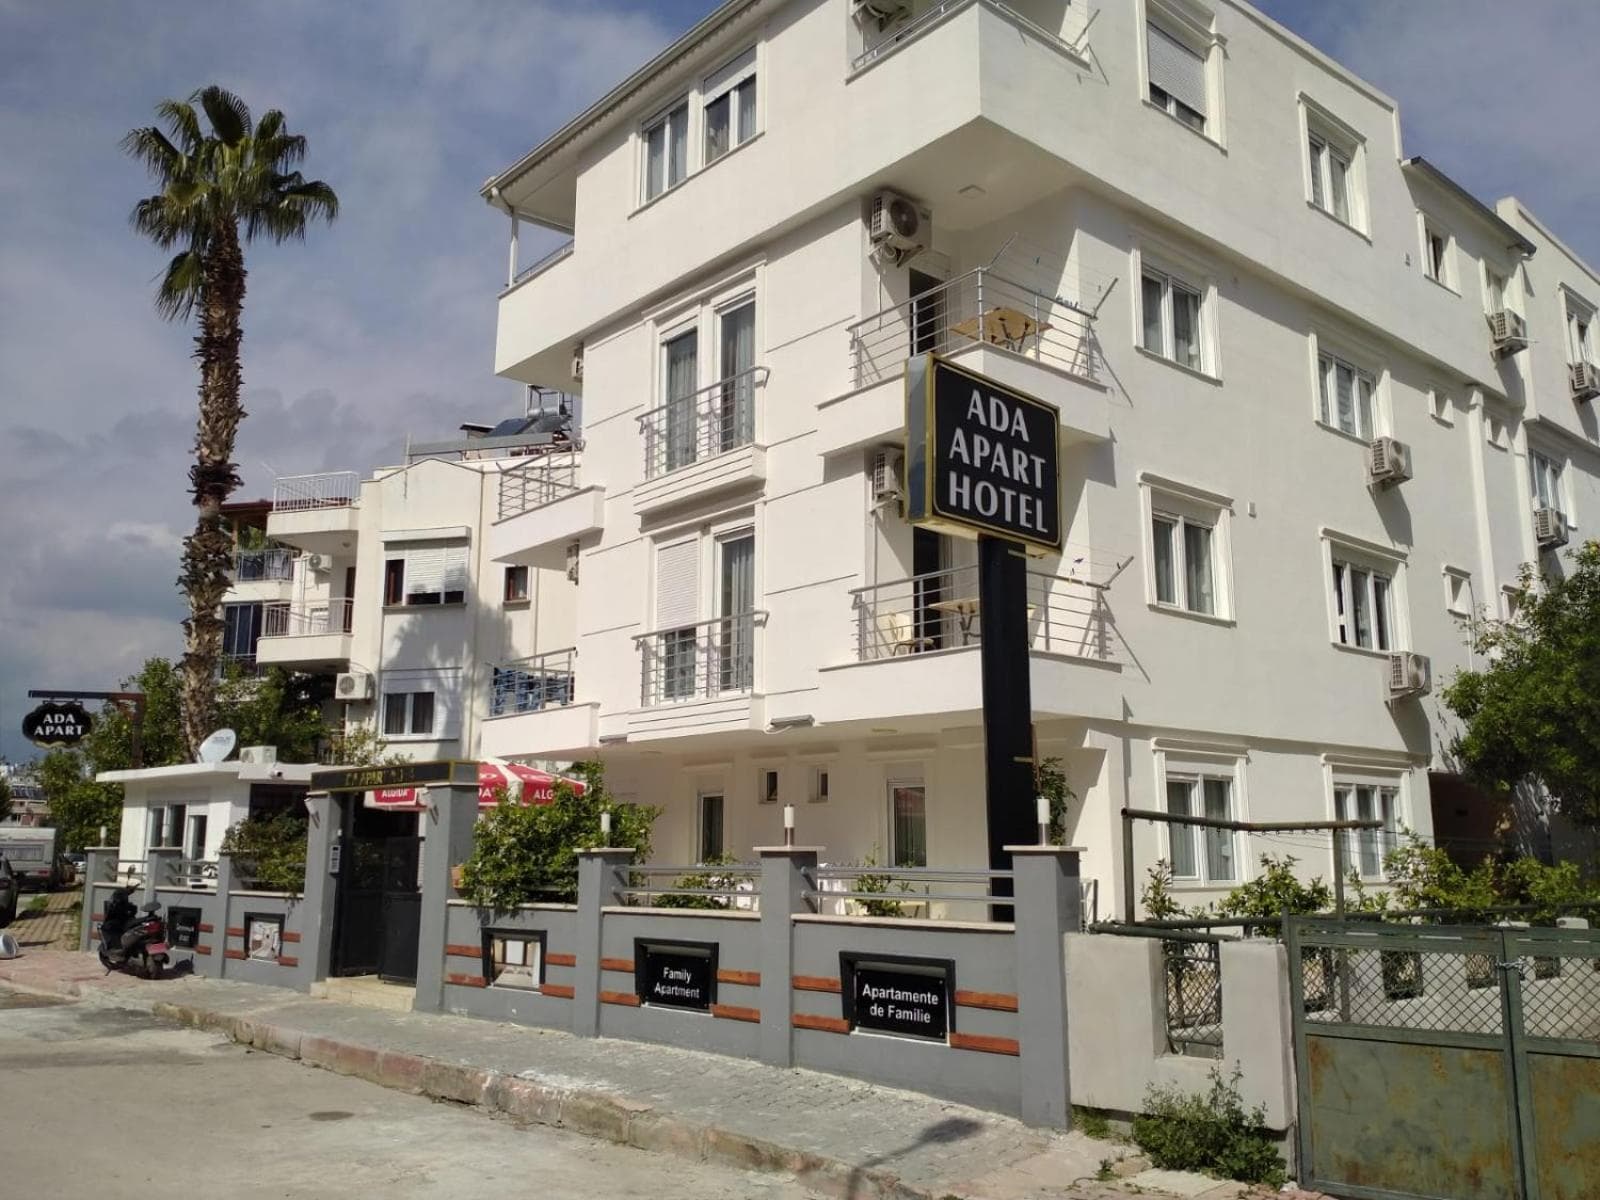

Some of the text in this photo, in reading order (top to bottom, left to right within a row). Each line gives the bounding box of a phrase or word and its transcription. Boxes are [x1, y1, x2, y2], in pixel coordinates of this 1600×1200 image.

[966, 388, 1030, 443] ADA
[949, 427, 1046, 489] APART
[949, 470, 1049, 534] HOTEL
[43, 713, 76, 724] ADA
[33, 725, 84, 736] APART
[533, 787, 554, 800] ALG
[663, 966, 692, 984] Family
[654, 982, 700, 998] Apartment
[862, 983, 939, 1005] Apartamente
[869, 1003, 931, 1023] de Familie
